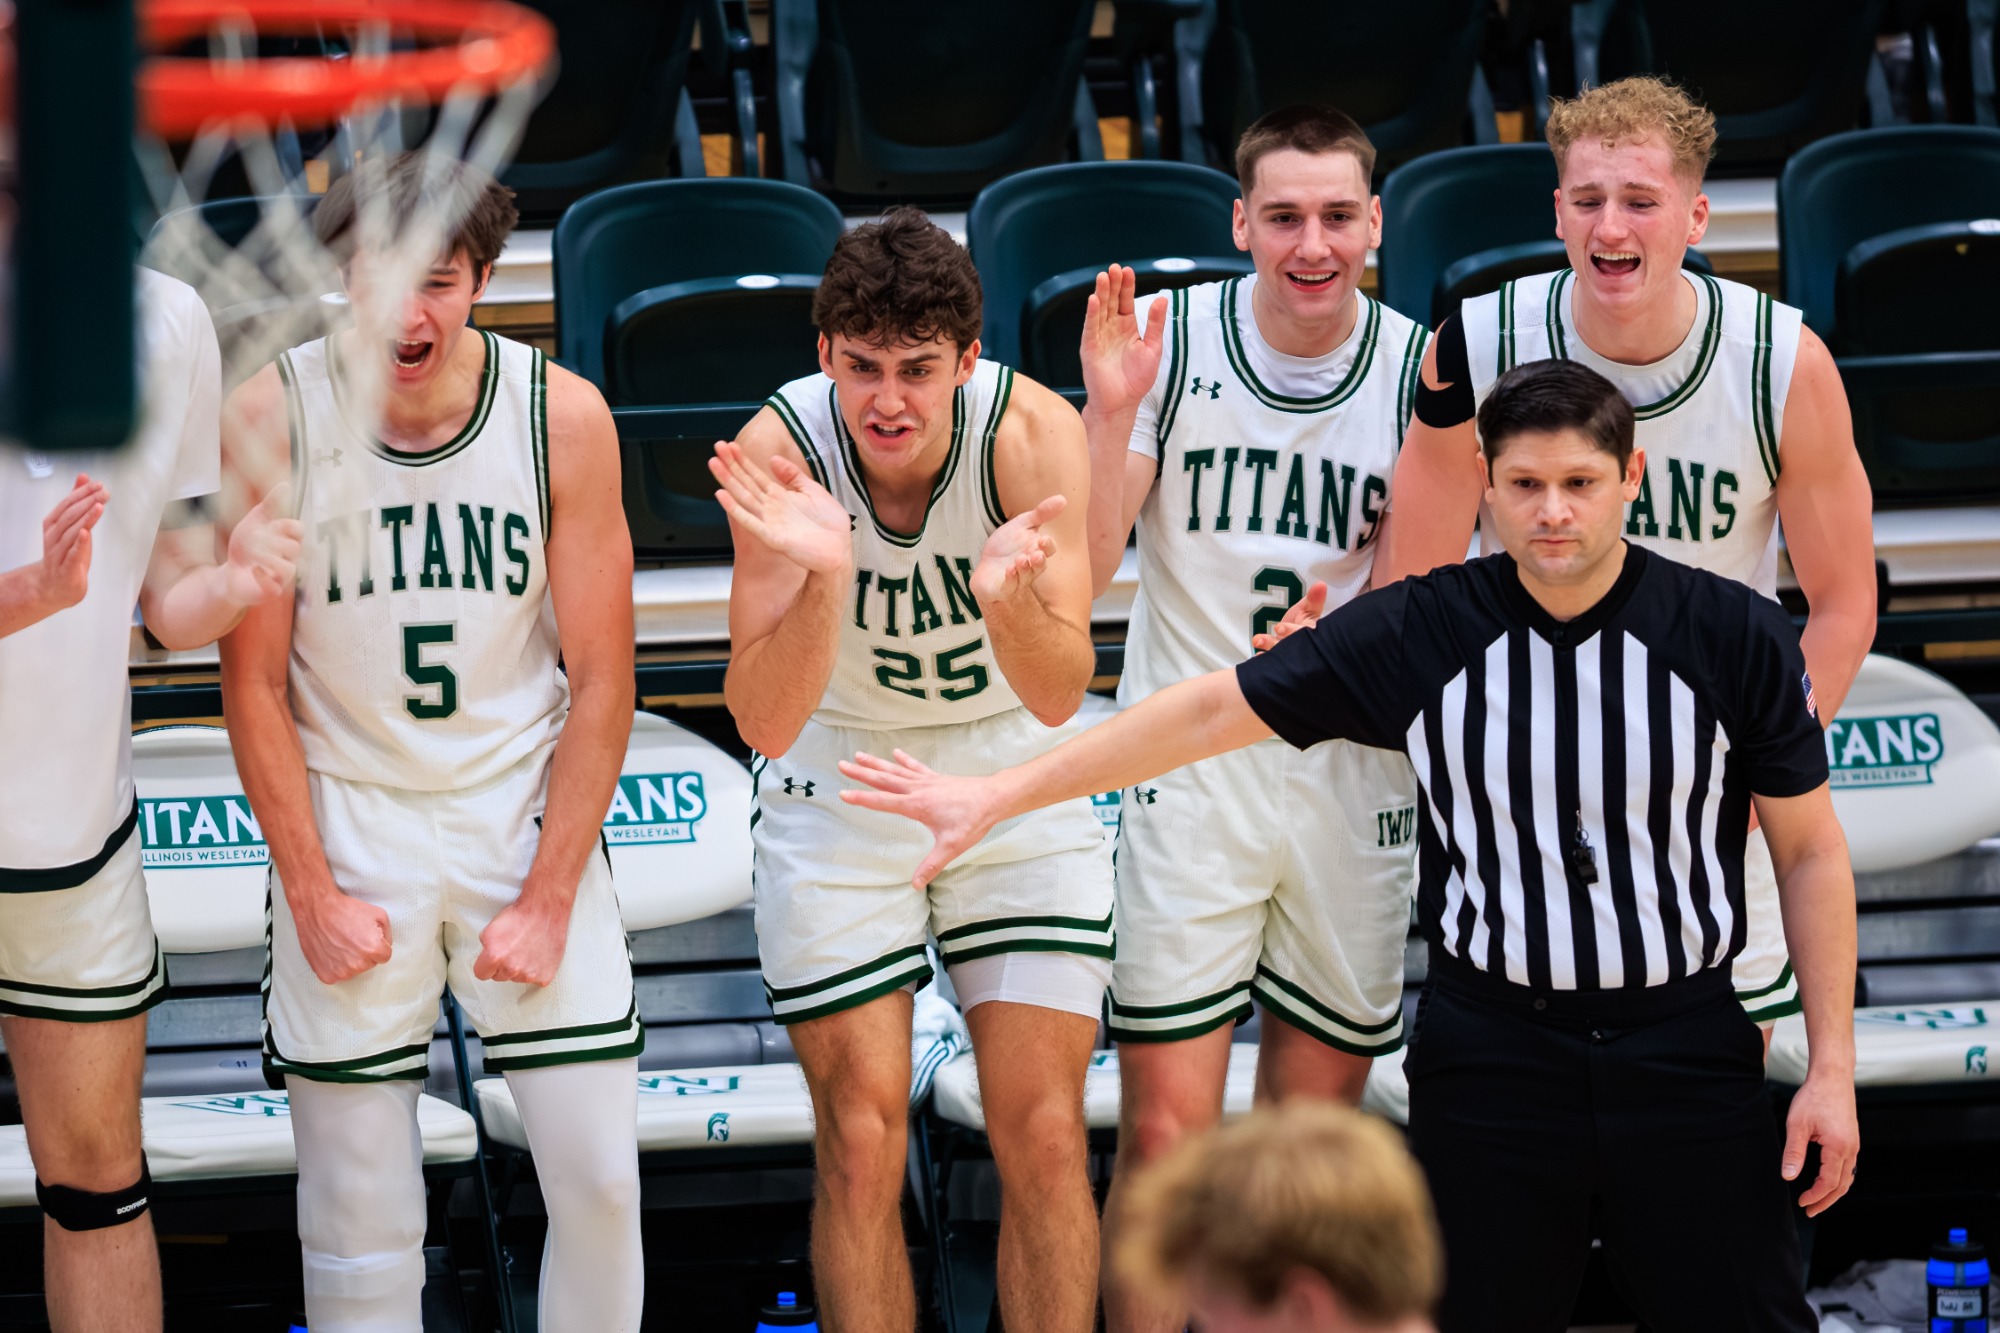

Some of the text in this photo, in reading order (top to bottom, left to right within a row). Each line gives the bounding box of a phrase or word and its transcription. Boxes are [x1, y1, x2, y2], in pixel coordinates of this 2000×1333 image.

[1183, 447, 1387, 551] TITANS
[1625, 457, 1739, 543] ANS
[316, 502, 531, 605] TITANS
[401, 620, 460, 721] 5
[871, 635, 991, 702] 25
[138, 799, 264, 845] ITAN
[611, 827, 680, 838] WESLEYAN
[1377, 807, 1414, 847] IWU
[141, 849, 265, 863] ILLINOIS WESLEYAN
